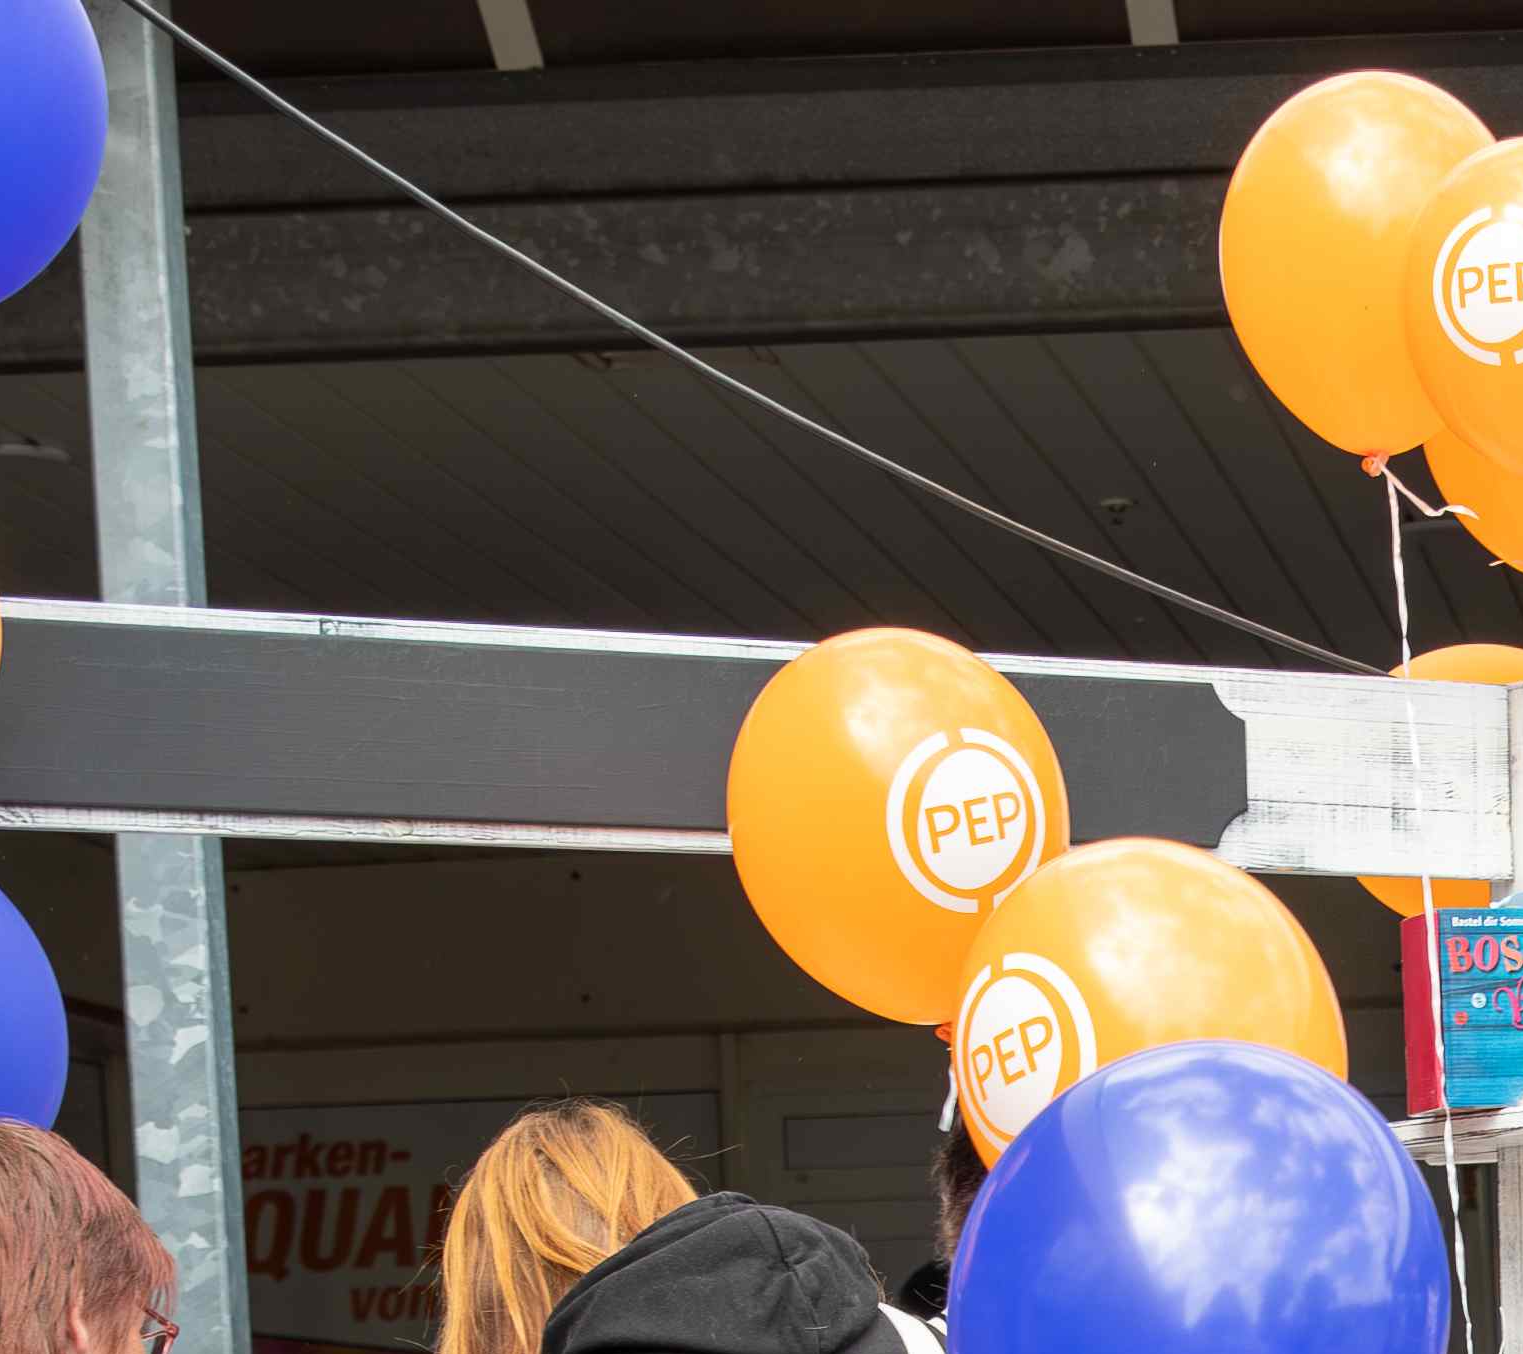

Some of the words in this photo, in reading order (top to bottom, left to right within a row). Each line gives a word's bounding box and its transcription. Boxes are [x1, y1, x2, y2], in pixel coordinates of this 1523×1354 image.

[924, 791, 1022, 854] PEP
[971, 1014, 1054, 1101] PEP
[242, 1133, 412, 1181] arken-
